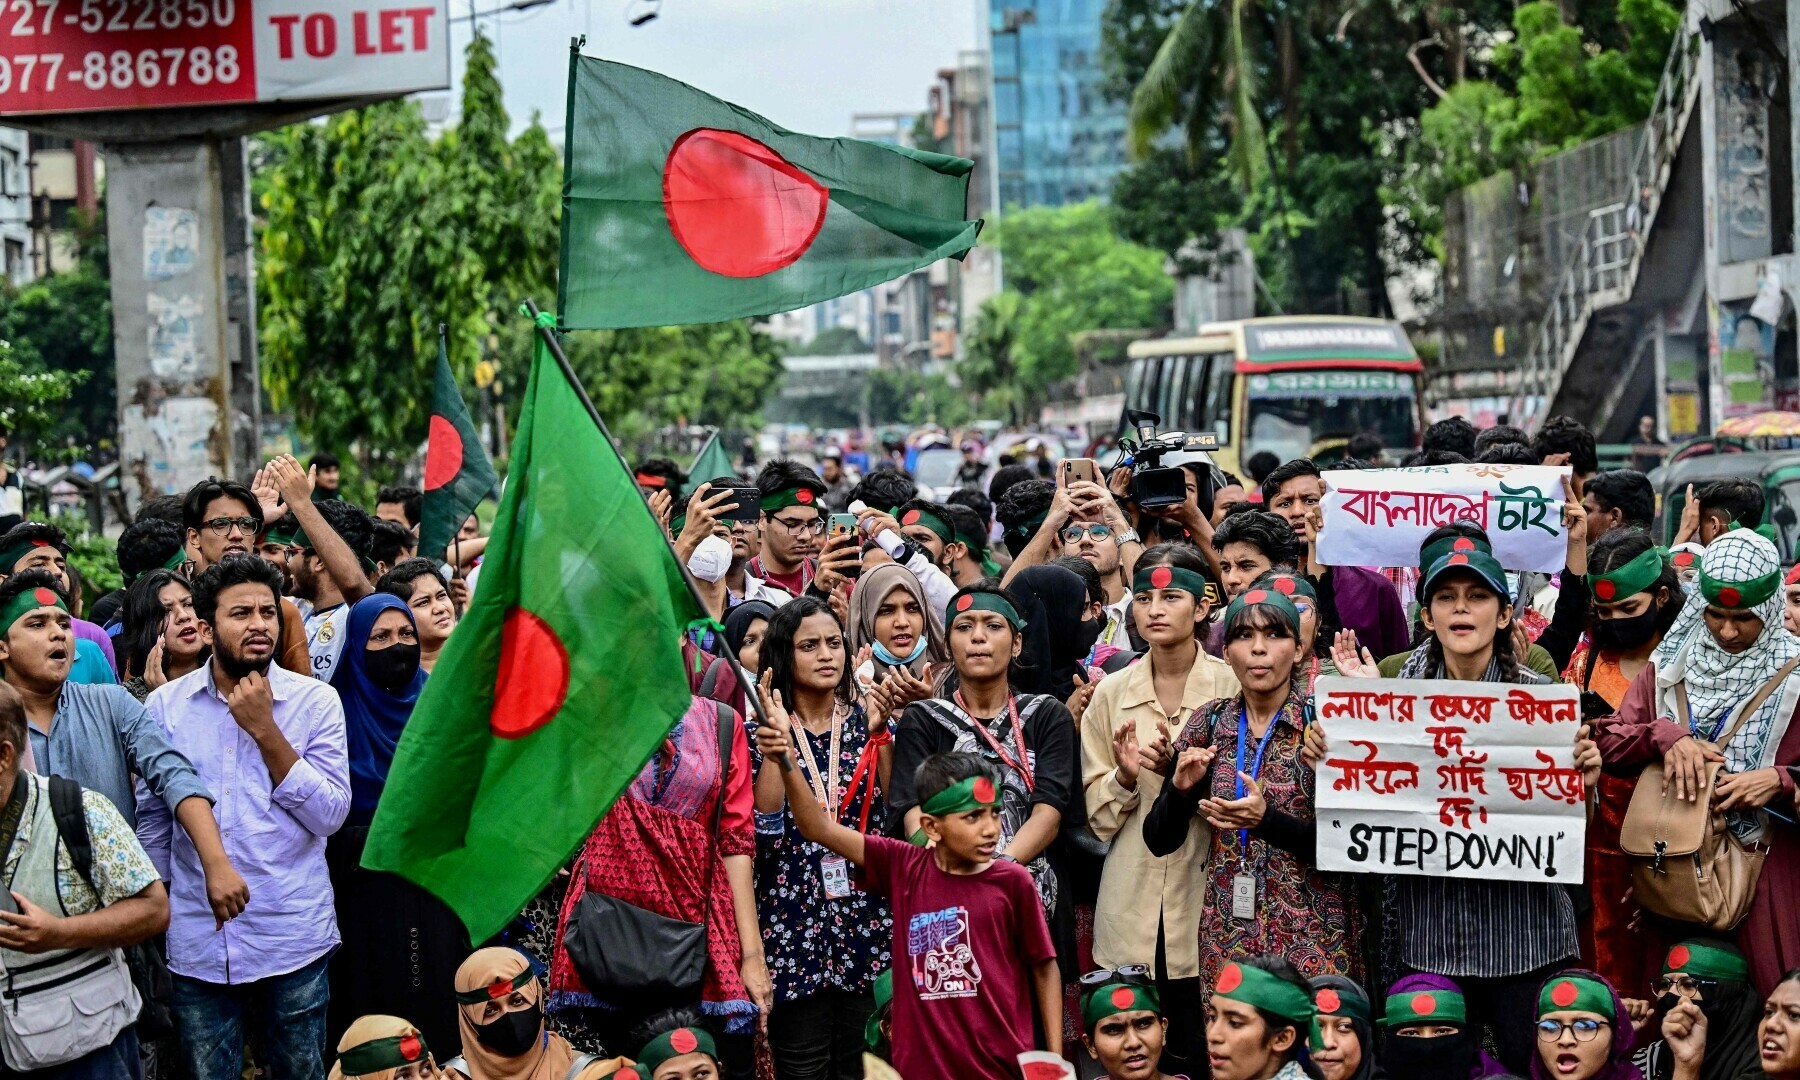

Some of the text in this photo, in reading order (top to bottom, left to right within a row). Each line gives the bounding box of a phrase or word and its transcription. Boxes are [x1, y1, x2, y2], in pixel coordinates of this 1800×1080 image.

[269, 8, 435, 59] TO LET
[1337, 488, 1494, 531] বাংলাদেশ
[1321, 691, 1418, 722] লাশের
[1505, 689, 1578, 725] জীবন
[1325, 740, 1420, 795] নাইলে
[1436, 752, 1488, 795] গদি
